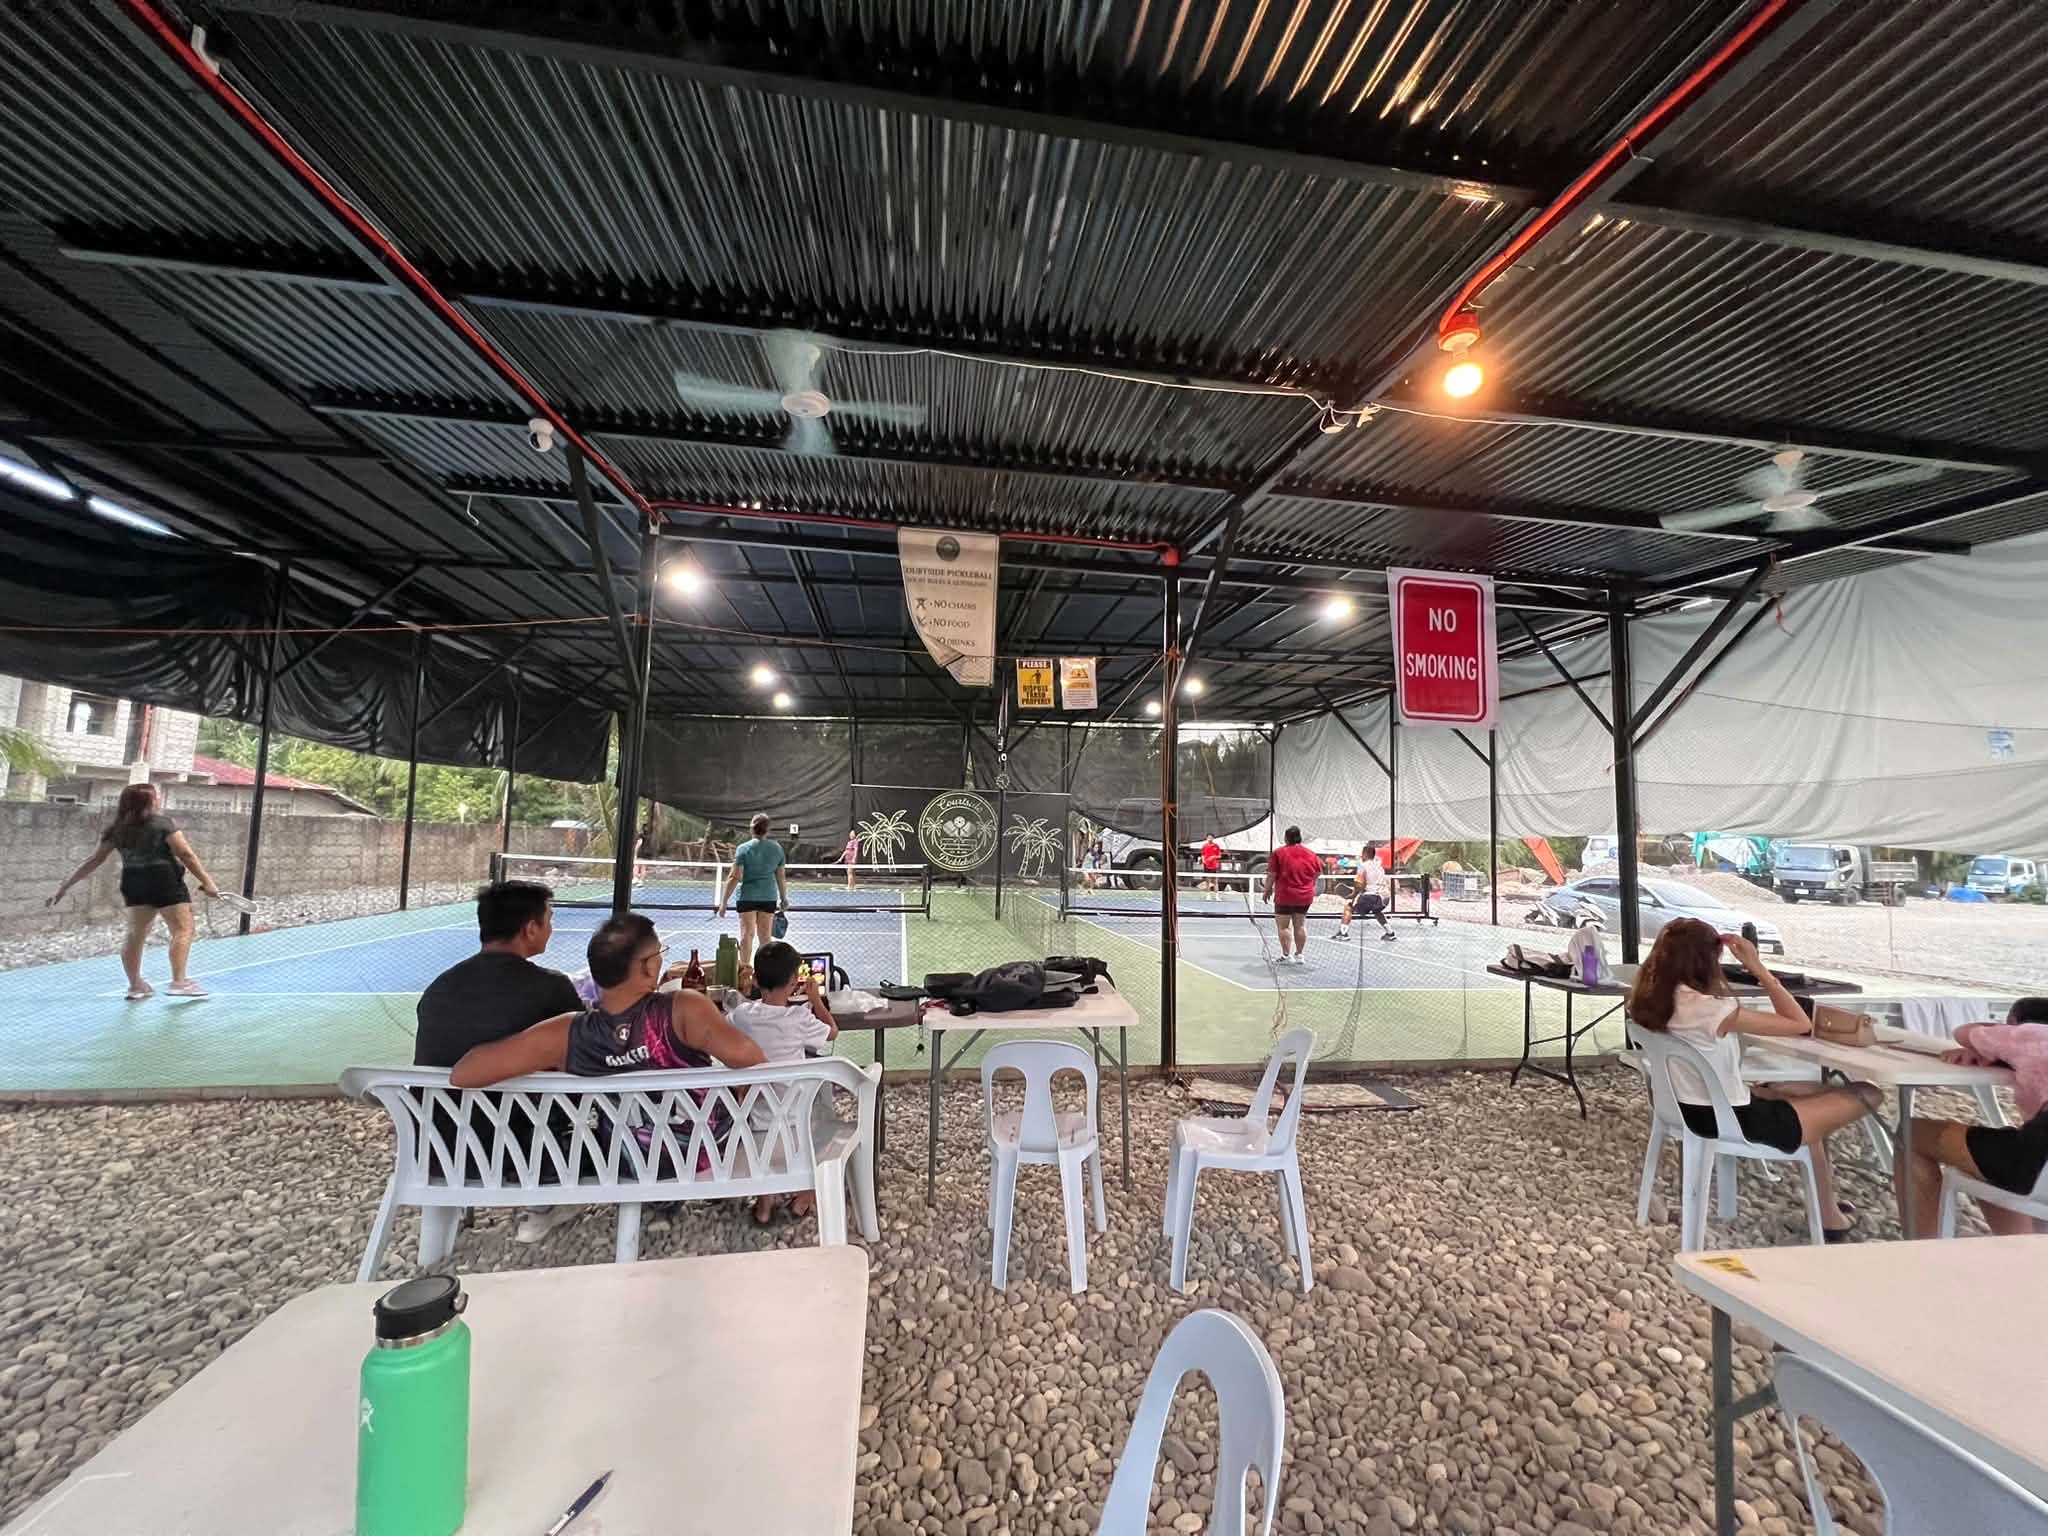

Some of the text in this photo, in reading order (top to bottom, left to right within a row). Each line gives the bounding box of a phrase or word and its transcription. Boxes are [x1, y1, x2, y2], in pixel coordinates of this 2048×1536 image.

[934, 600, 976, 610] NO CHAIRS
[933, 618, 970, 629] NO FOOD
[1429, 608, 1457, 632] NO
[947, 639, 976, 647] DRINKS
[1406, 653, 1477, 681] SMOKING
[937, 798, 983, 810] Courtside
